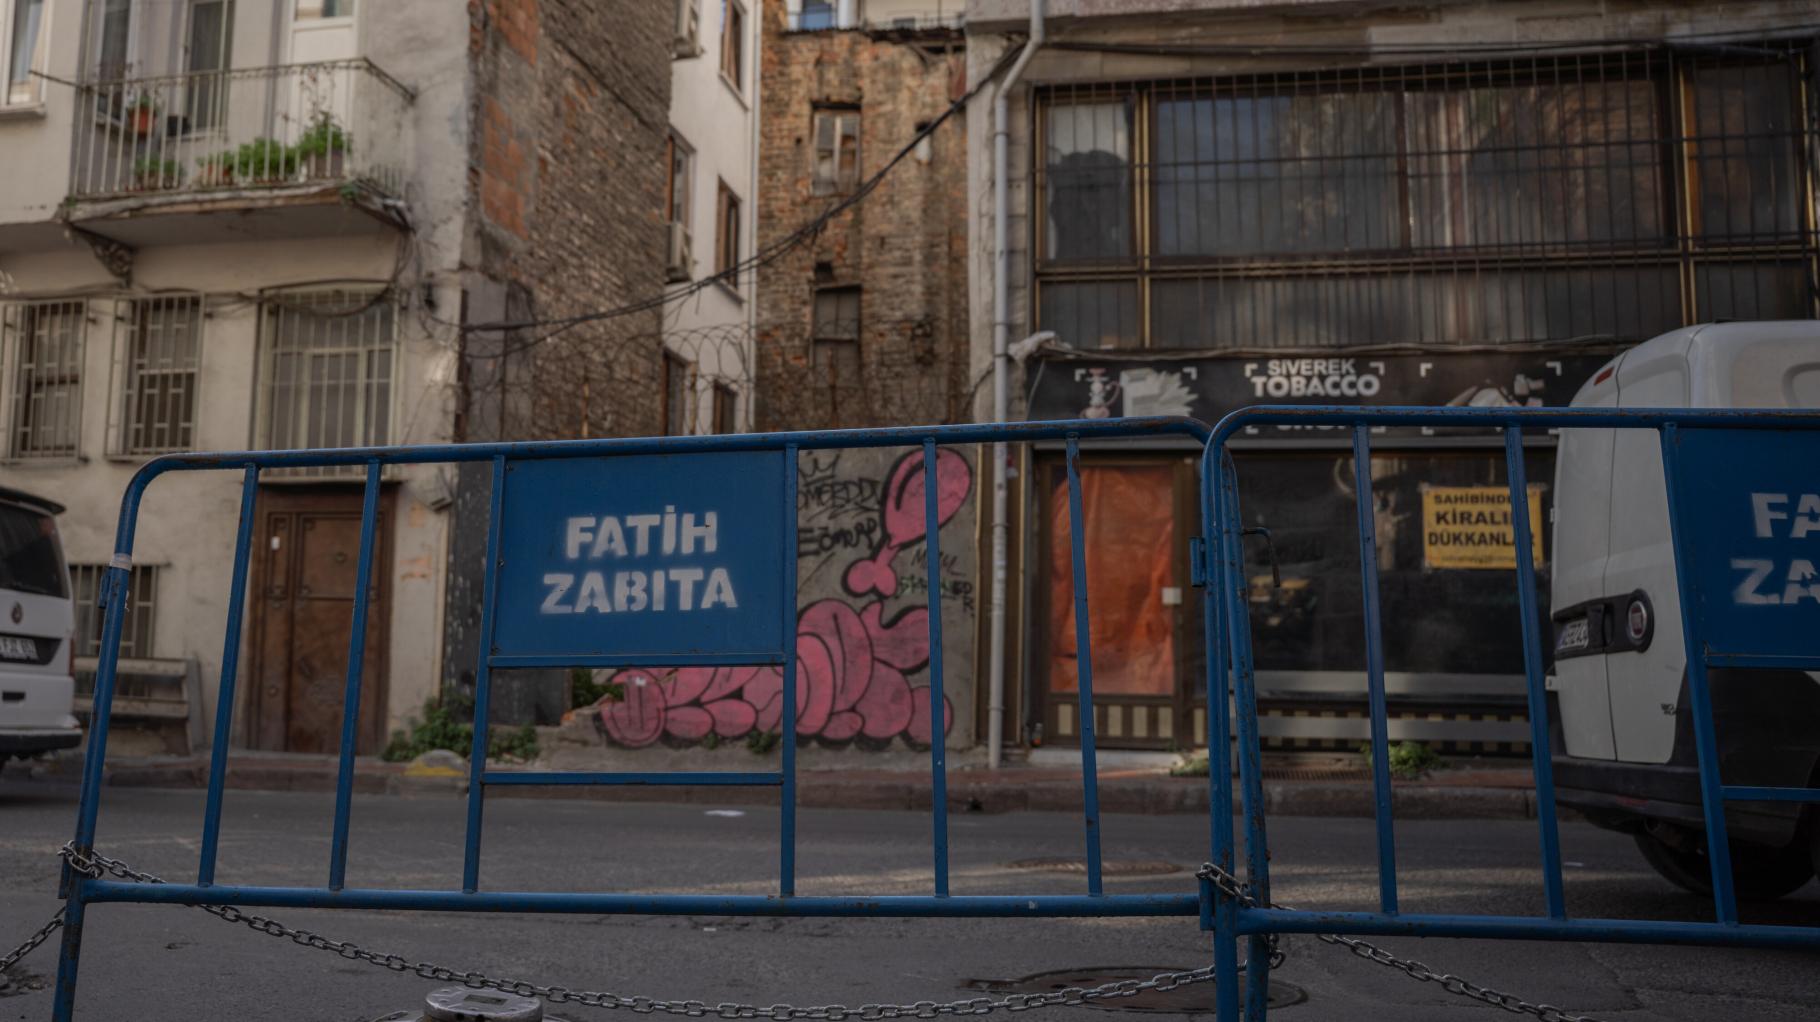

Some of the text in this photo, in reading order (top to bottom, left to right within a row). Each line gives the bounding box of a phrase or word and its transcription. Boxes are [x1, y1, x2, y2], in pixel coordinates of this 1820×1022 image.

[1251, 374, 1380, 397] TOBACCO
[1434, 492, 1511, 505] SAHİBİND
[1435, 508, 1513, 526] KİRALI
[565, 504, 718, 559] FATİH
[1428, 529, 1535, 546] DÜKKANL
[540, 567, 739, 614] ZABITA
